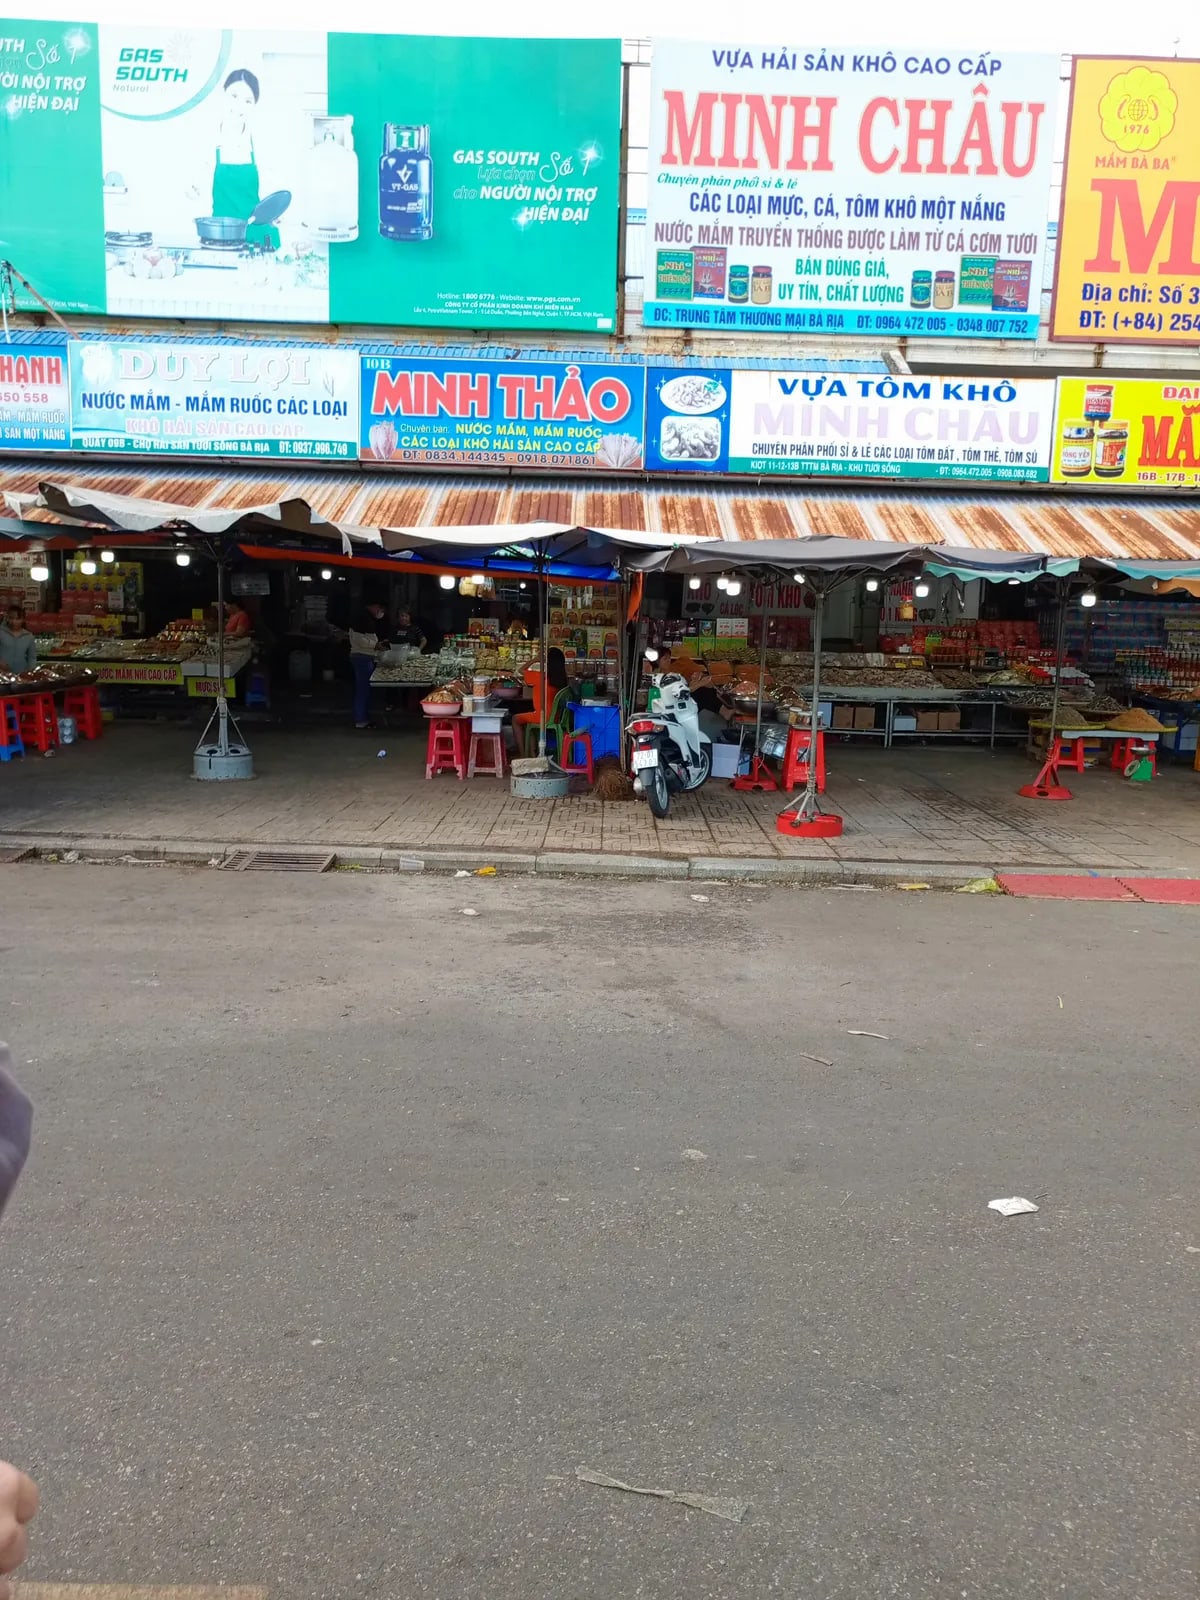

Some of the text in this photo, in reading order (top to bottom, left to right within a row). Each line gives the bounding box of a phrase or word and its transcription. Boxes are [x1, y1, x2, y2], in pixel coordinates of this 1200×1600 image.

[26, 38, 60, 70] Số
[119, 48, 164, 63] GAS
[712, 46, 1002, 77] VỰA HẢI SẢN KHÔ CAO CẤP
[22, 73, 87, 96] NỘI TRỢ
[115, 66, 189, 83] SOUTH
[113, 84, 150, 93] Natural
[13, 92, 79, 115] HIỆN ĐẠI
[660, 81, 1046, 178] MINH CHÂU
[1123, 124, 1150, 135] 1976
[453, 150, 574, 183] GAS SOUTH Số
[1095, 152, 1149, 170] MẮM BÀ
[391, 182, 419, 192] VT-GAS
[657, 172, 760, 190] Chuyên phân phối
[480, 184, 532, 201] NGƯỜI
[533, 185, 562, 205] NỘI
[566, 187, 598, 205] TRỢ
[690, 188, 1006, 224] CÁC LOẠI MỰC, CÁ, TÔM KHÔ MỘT NẮNG
[524, 205, 590, 226] HIỆN ĐẠI
[654, 218, 1038, 255] NƯỚC MẮM TRUYỀN THỐNG ĐƯỢC LÀM TỪ CÁ CƠM TƯƠI
[795, 254, 890, 279] BÁN ĐÚNG GIÁ,
[778, 283, 795, 300] UY
[799, 279, 822, 303] TÍN,
[826, 280, 859, 302] CHẤT
[862, 284, 904, 306] LƯỢNG
[1081, 282, 1185, 306] Địa chỉ: Số
[654, 307, 1028, 334] ĐC: TRUNG TÂM THƯƠNG MẠI BÀ RỊA ĐT: 0964 472 005 752
[1079, 310, 1200, 332] ĐT: (+84) 254
[119, 350, 310, 391] DUY LỢI
[23, 392, 49, 404] 558
[370, 364, 632, 424] MINH THẢO
[777, 374, 1017, 403] VỰA TÔM KHÔ
[81, 388, 348, 420] NƯỚC MẮM MẮM RUỐC CÁC LOẠI
[126, 416, 267, 436] KHÔ HẢI SẢN CAO
[400, 421, 602, 439] Chuyên NƯỚC MẮM, MẮM RUỐC
[753, 401, 1040, 445] MINH CHÂU
[401, 434, 601, 453] CÁC LOẠI KHÔ HẢI SẢN CAO CẤP
[752, 440, 1023, 464] CHUYÊN PHÂN PHỐI CÁC LOẠI TÔM ĐẤT TÔM TÔM
[403, 450, 597, 465] ĐT: 0834.144345 0918.071861
[820, 461, 830, 472] BÀ
[848, 463, 863, 473] KHU
[881, 461, 901, 474] SỐNG
[939, 466, 951, 476] ĐT:
[1137, 471, 1186, 482] 16B 17B
